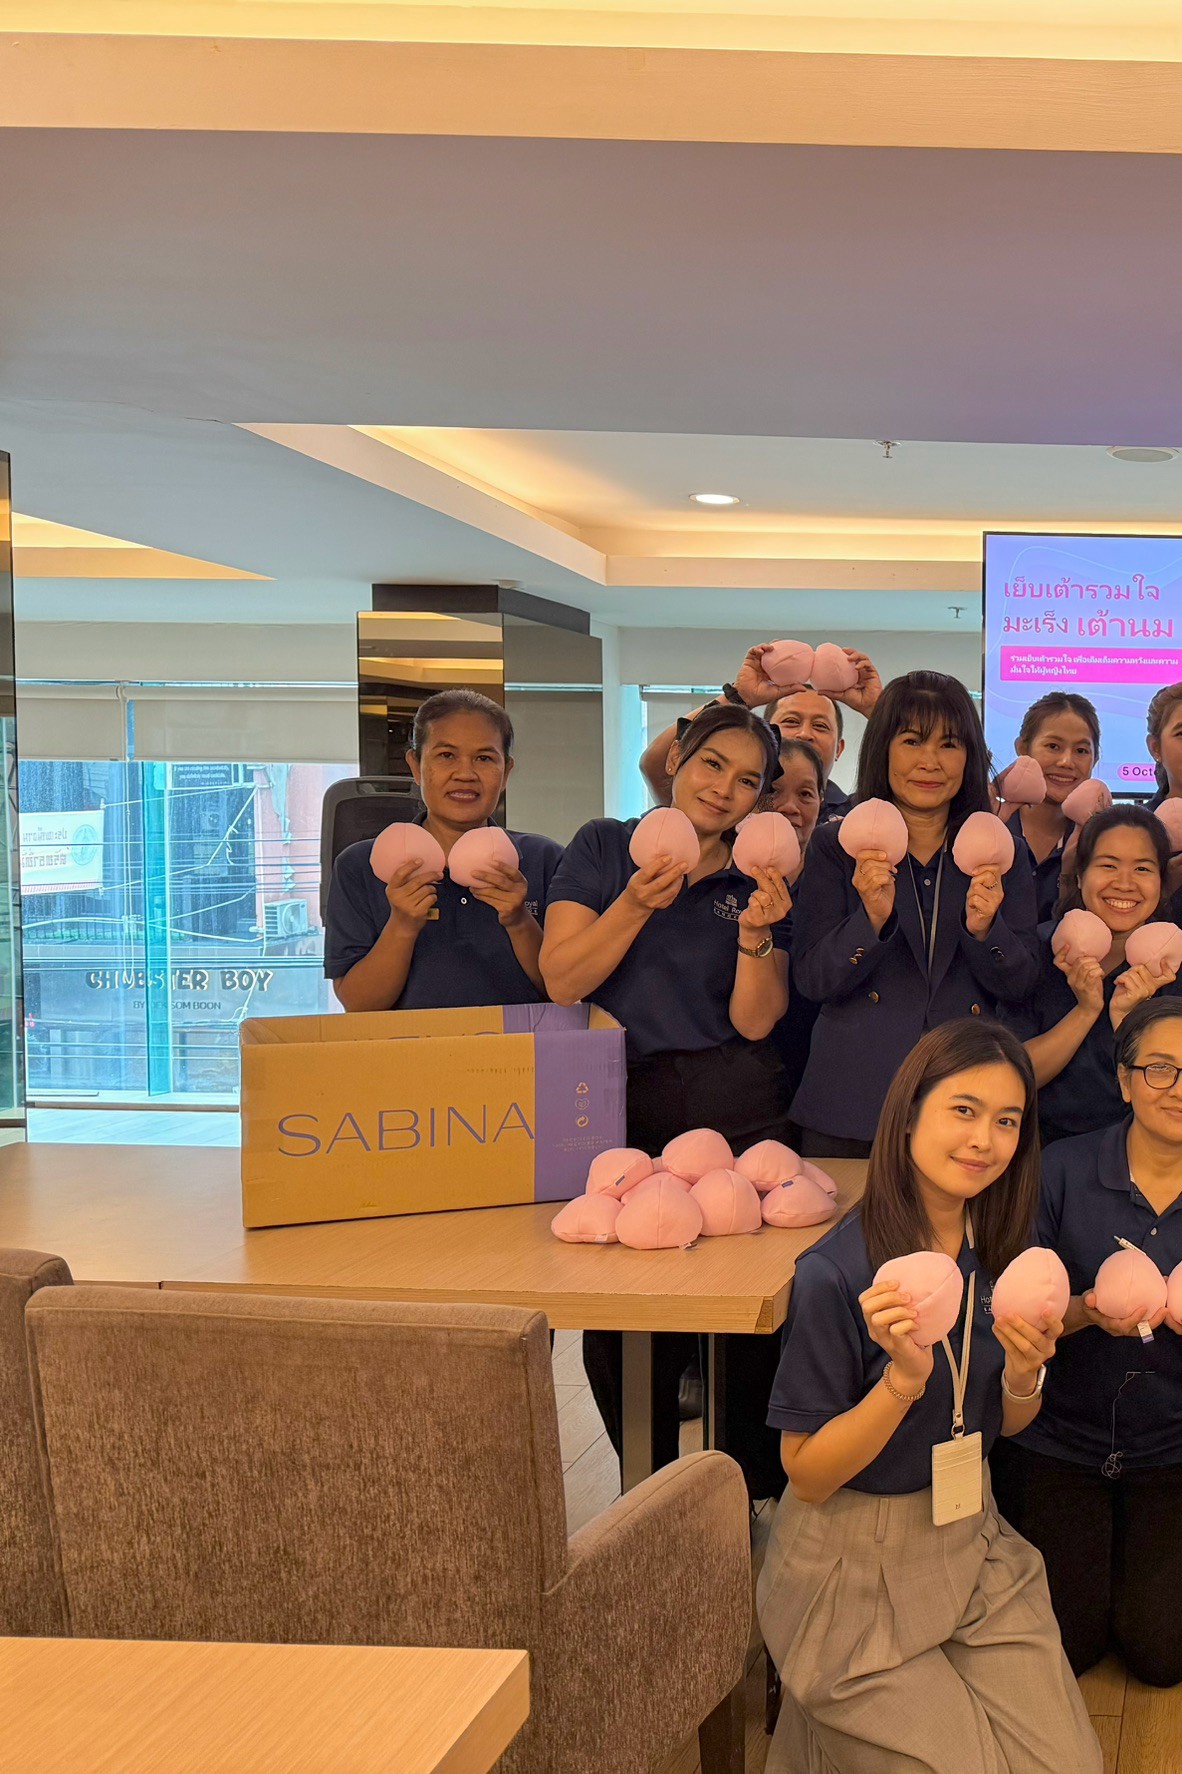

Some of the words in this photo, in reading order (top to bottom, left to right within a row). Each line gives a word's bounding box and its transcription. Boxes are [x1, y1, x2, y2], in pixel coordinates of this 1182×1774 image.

[1004, 573, 1160, 601] เย็บเต้ารวมใจ
[1003, 609, 1068, 634] มะเร็ง
[1077, 609, 1174, 638] เต้านม
[1122, 766, 1130, 776] 5
[220, 968, 274, 992] BOY
[171, 1001, 191, 1009] SOM
[193, 1001, 221, 1010] BOON
[277, 1102, 535, 1157] SABINA
